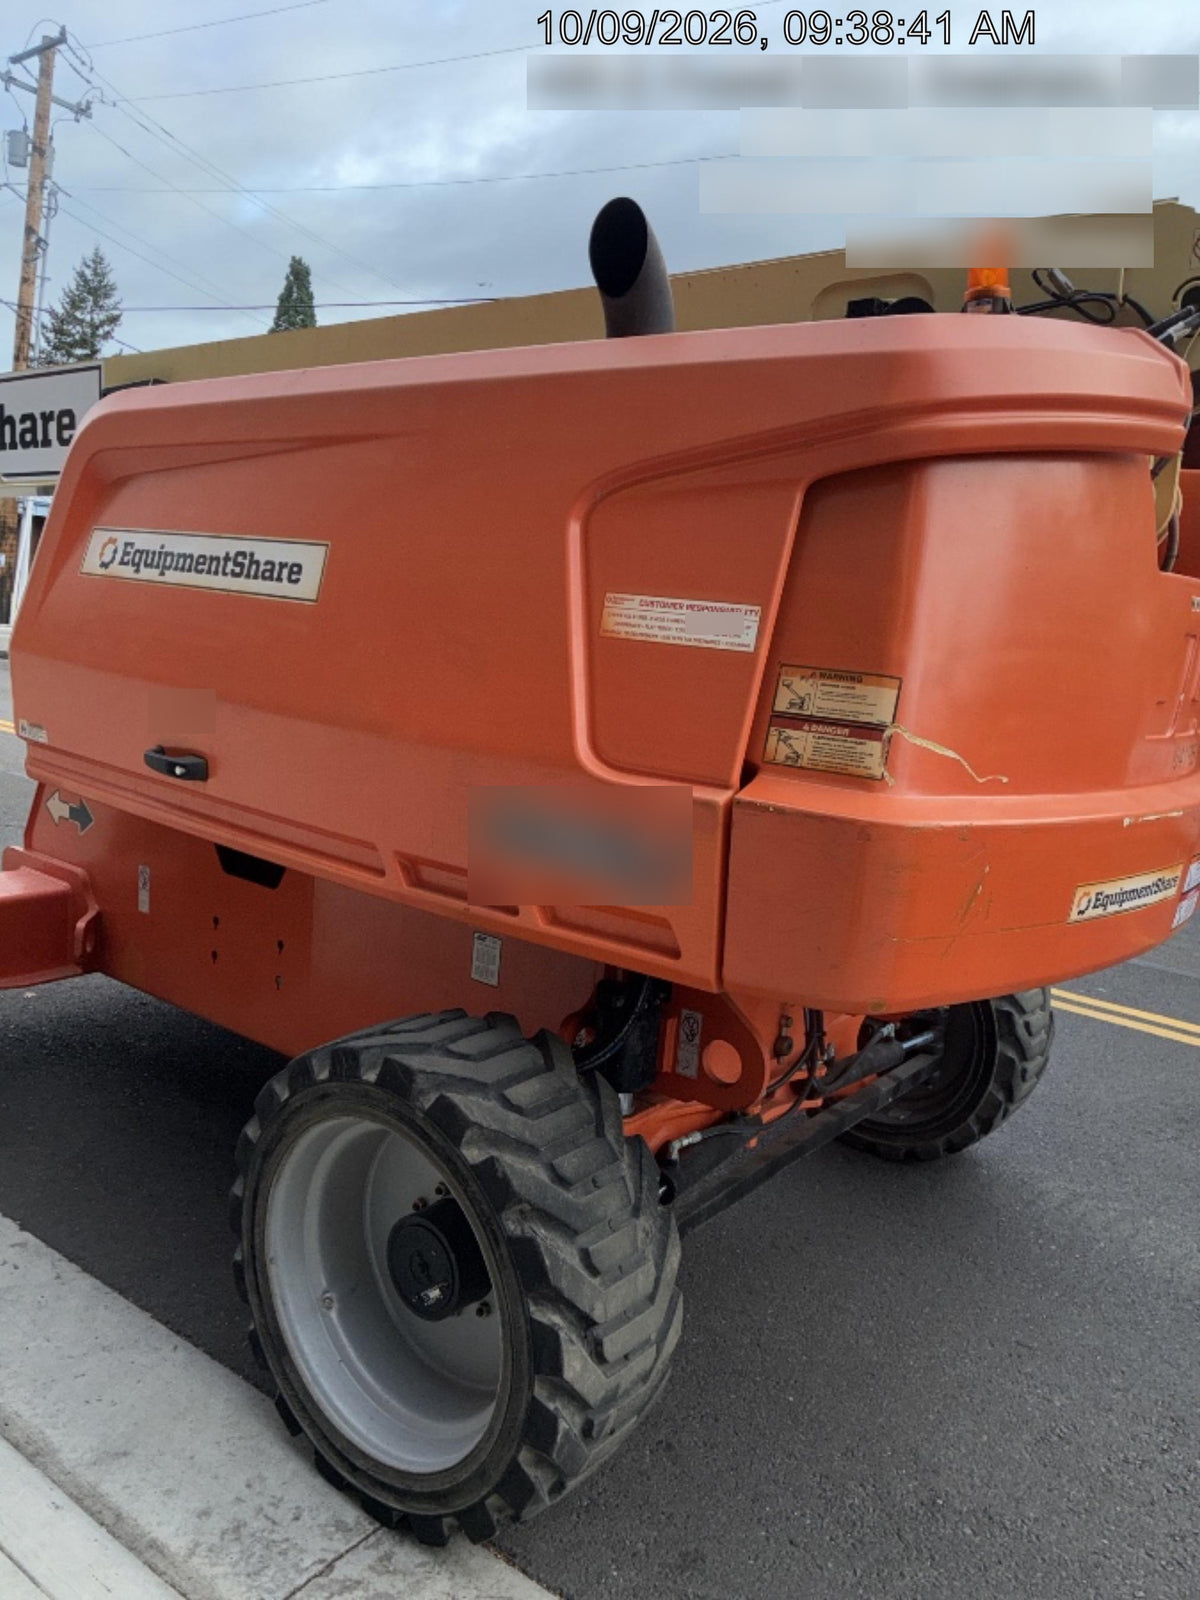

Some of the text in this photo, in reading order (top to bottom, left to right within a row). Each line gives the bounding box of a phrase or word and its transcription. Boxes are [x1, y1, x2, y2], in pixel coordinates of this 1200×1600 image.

[0, 403, 76, 451] hare
[118, 541, 303, 584] EquipmentShare
[639, 599, 684, 612] CUSTOMER
[818, 671, 863, 683] WARNING
[810, 723, 851, 736] DANGER
